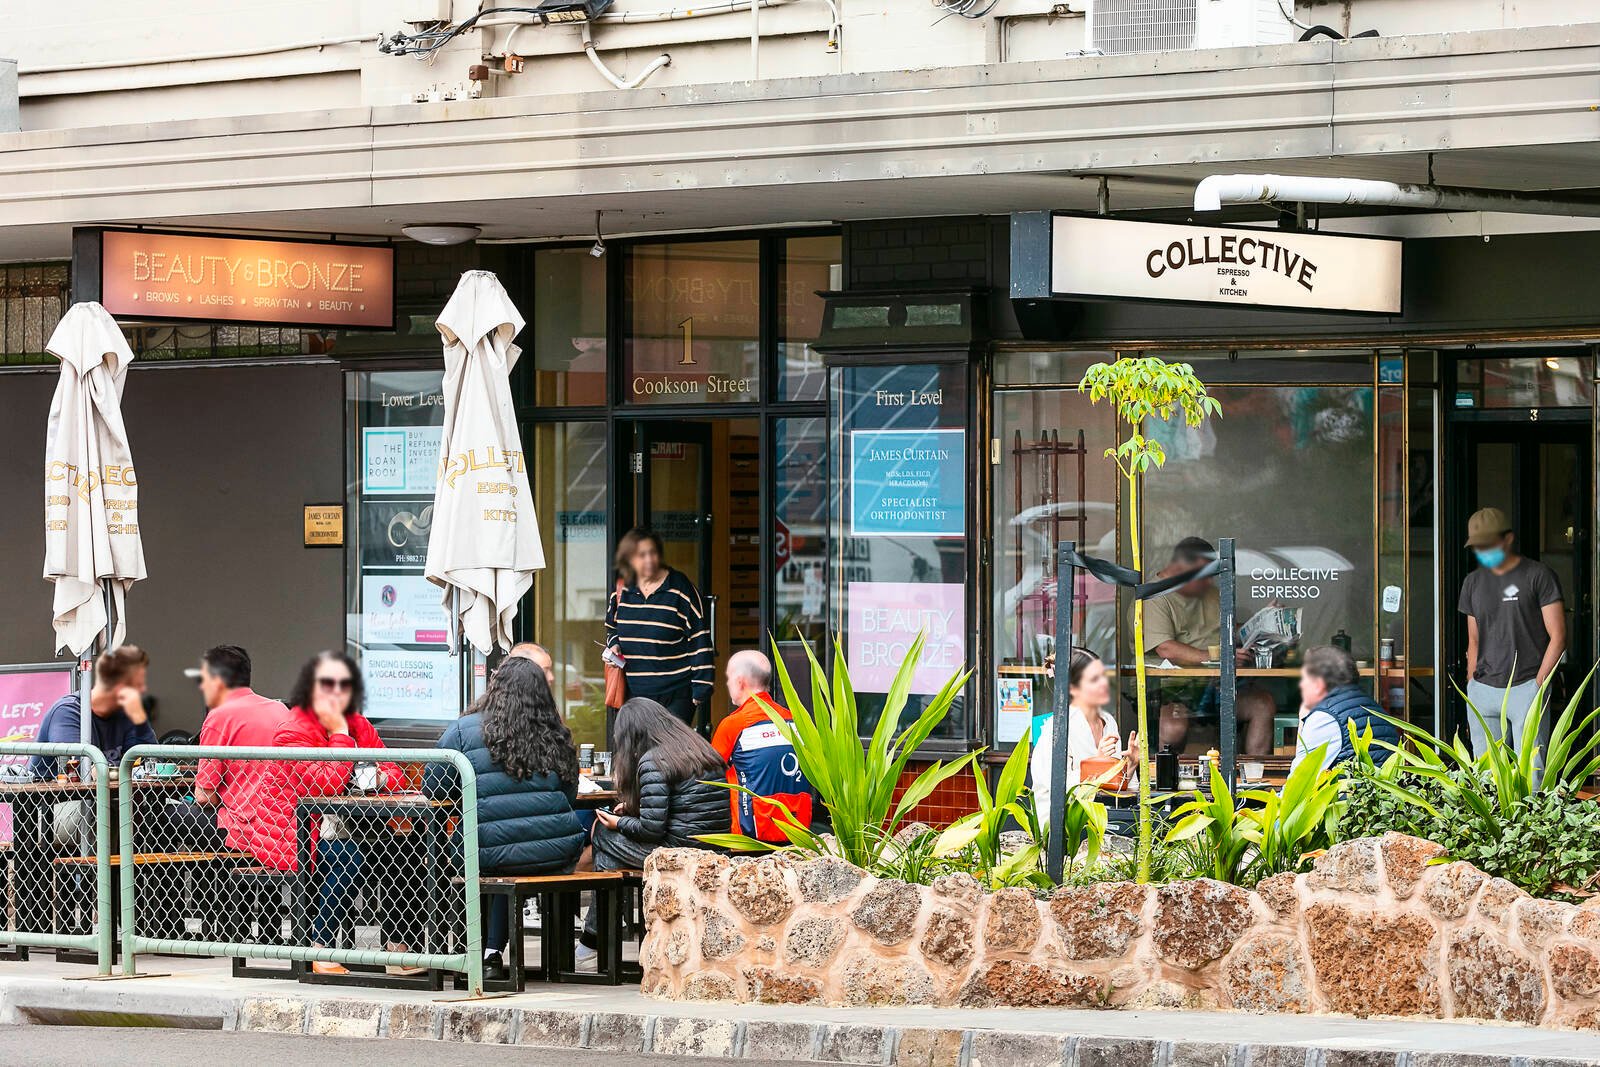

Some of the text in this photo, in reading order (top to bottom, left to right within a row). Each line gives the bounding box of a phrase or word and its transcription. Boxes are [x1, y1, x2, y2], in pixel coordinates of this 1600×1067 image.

[1146, 235, 1318, 292] COLLECTIVE
[133, 251, 243, 286] BEAUTY
[257, 259, 365, 293] BRONZE
[1217, 267, 1250, 277] ESPRESSO
[1230, 277, 1237, 286] &
[1219, 287, 1248, 297] KITCHEN
[145, 291, 180, 304] BROWS
[199, 294, 234, 306] LASHES
[319, 300, 353, 312] BEAUTY
[677, 316, 698, 366] 1
[633, 375, 752, 396] Cookson Street
[381, 391, 445, 407] Lower Leve
[875, 389, 944, 407] First Level
[1530, 409, 1538, 422] 3
[408, 431, 424, 439] BUY
[384, 444, 402, 454] THE
[408, 440, 442, 448] REFINAN
[408, 449, 438, 457] INVEST
[870, 447, 949, 462] JAMES CURTAIN
[369, 456, 396, 466] LOAN
[369, 468, 397, 478] ROOM
[881, 497, 938, 508] SPECIALIST
[308, 512, 322, 521] JAMES
[870, 510, 947, 521] ORTHODONTIST
[395, 554, 406, 563] PH:
[1250, 567, 1339, 581] COLLECTIVE
[1250, 585, 1321, 600] ESPRESSO
[862, 607, 956, 633] BEAUTY
[861, 640, 956, 668] BROZE
[368, 659, 434, 670] SINGING LESSONS
[375, 670, 397, 679] VOCAL
[397, 670, 434, 680] COACHING
[369, 685, 394, 700] 0419
[414, 687, 433, 701] 454
[1, 702, 44, 719] LET'S
